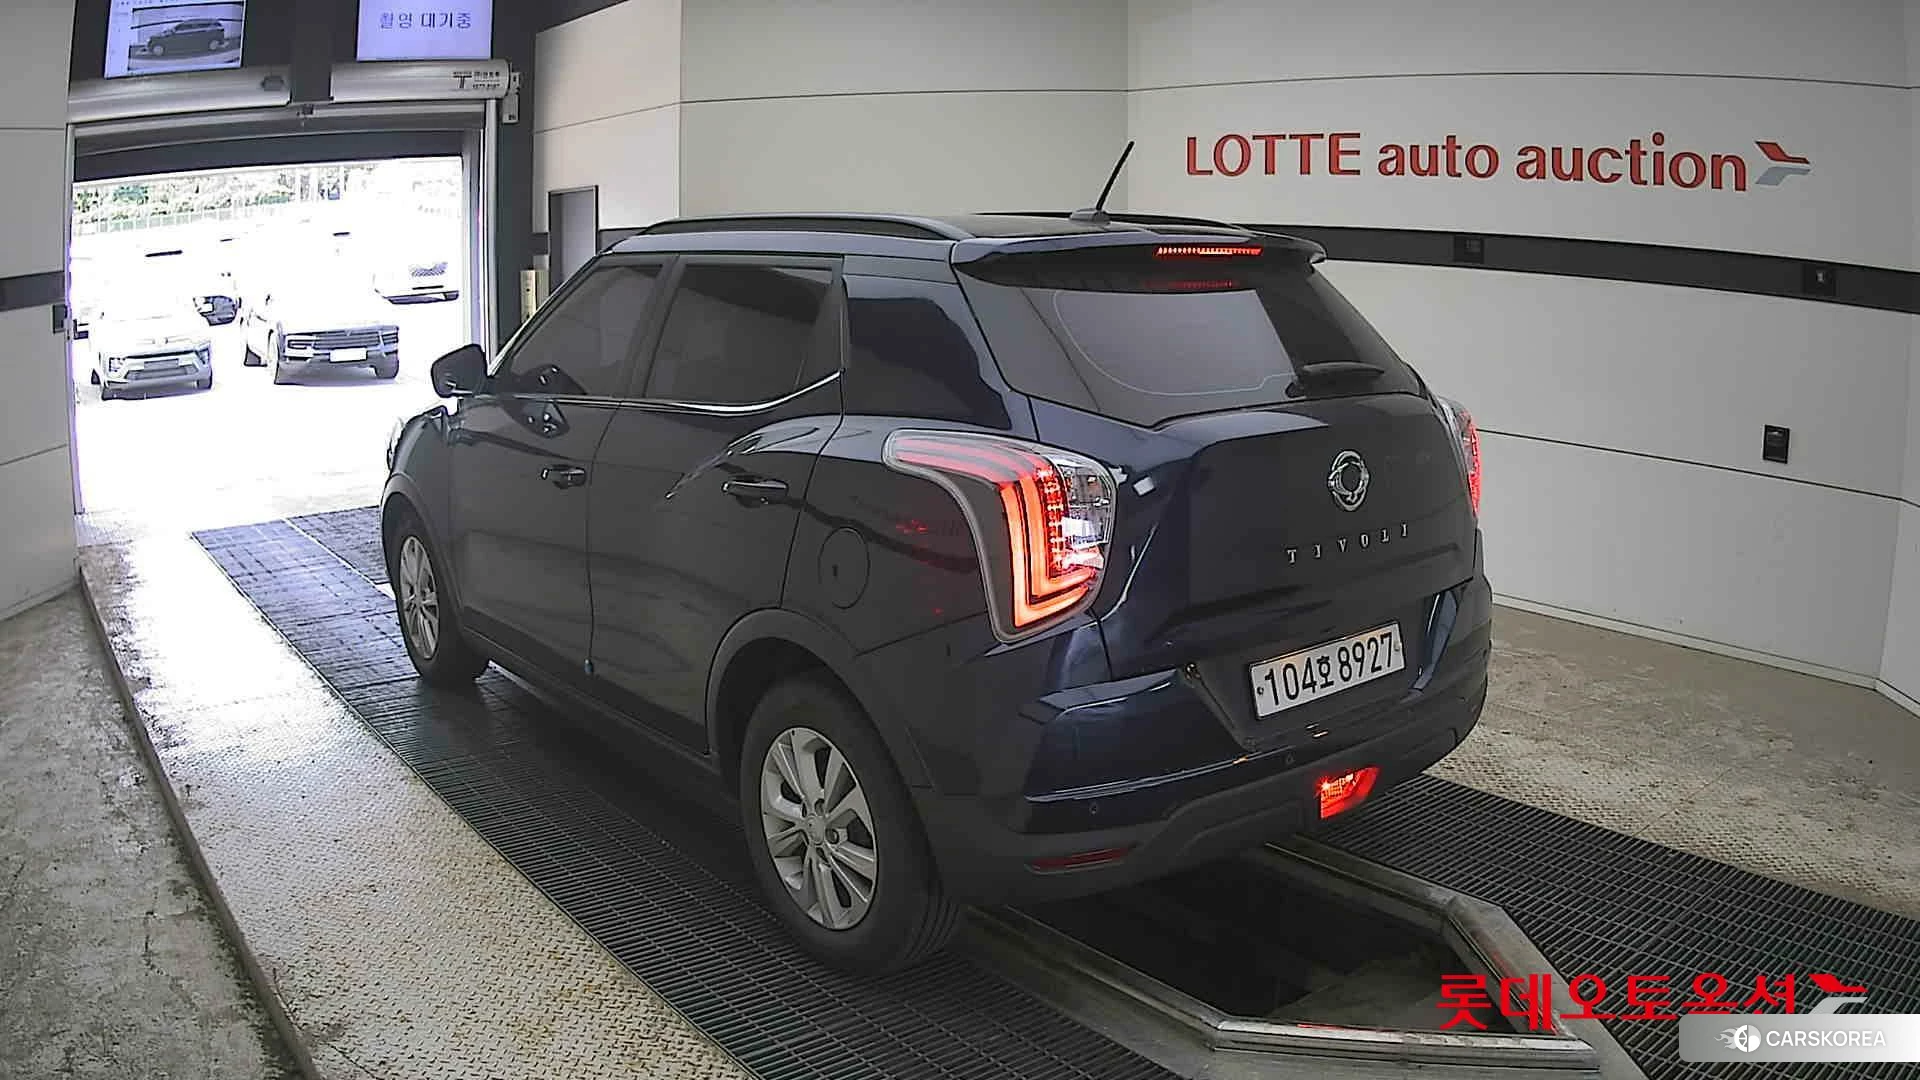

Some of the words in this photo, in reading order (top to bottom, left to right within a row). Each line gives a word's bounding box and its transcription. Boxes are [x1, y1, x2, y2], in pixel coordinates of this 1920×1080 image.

[421, 12, 471, 29] 대기중
[1186, 133, 1361, 176] LOTTE
[1378, 134, 1500, 178] auto
[1516, 132, 1748, 192] auction
[1286, 523, 1408, 565] TIVOLI
[1264, 655, 1335, 706] 104호
[1337, 632, 1393, 684] 8927
